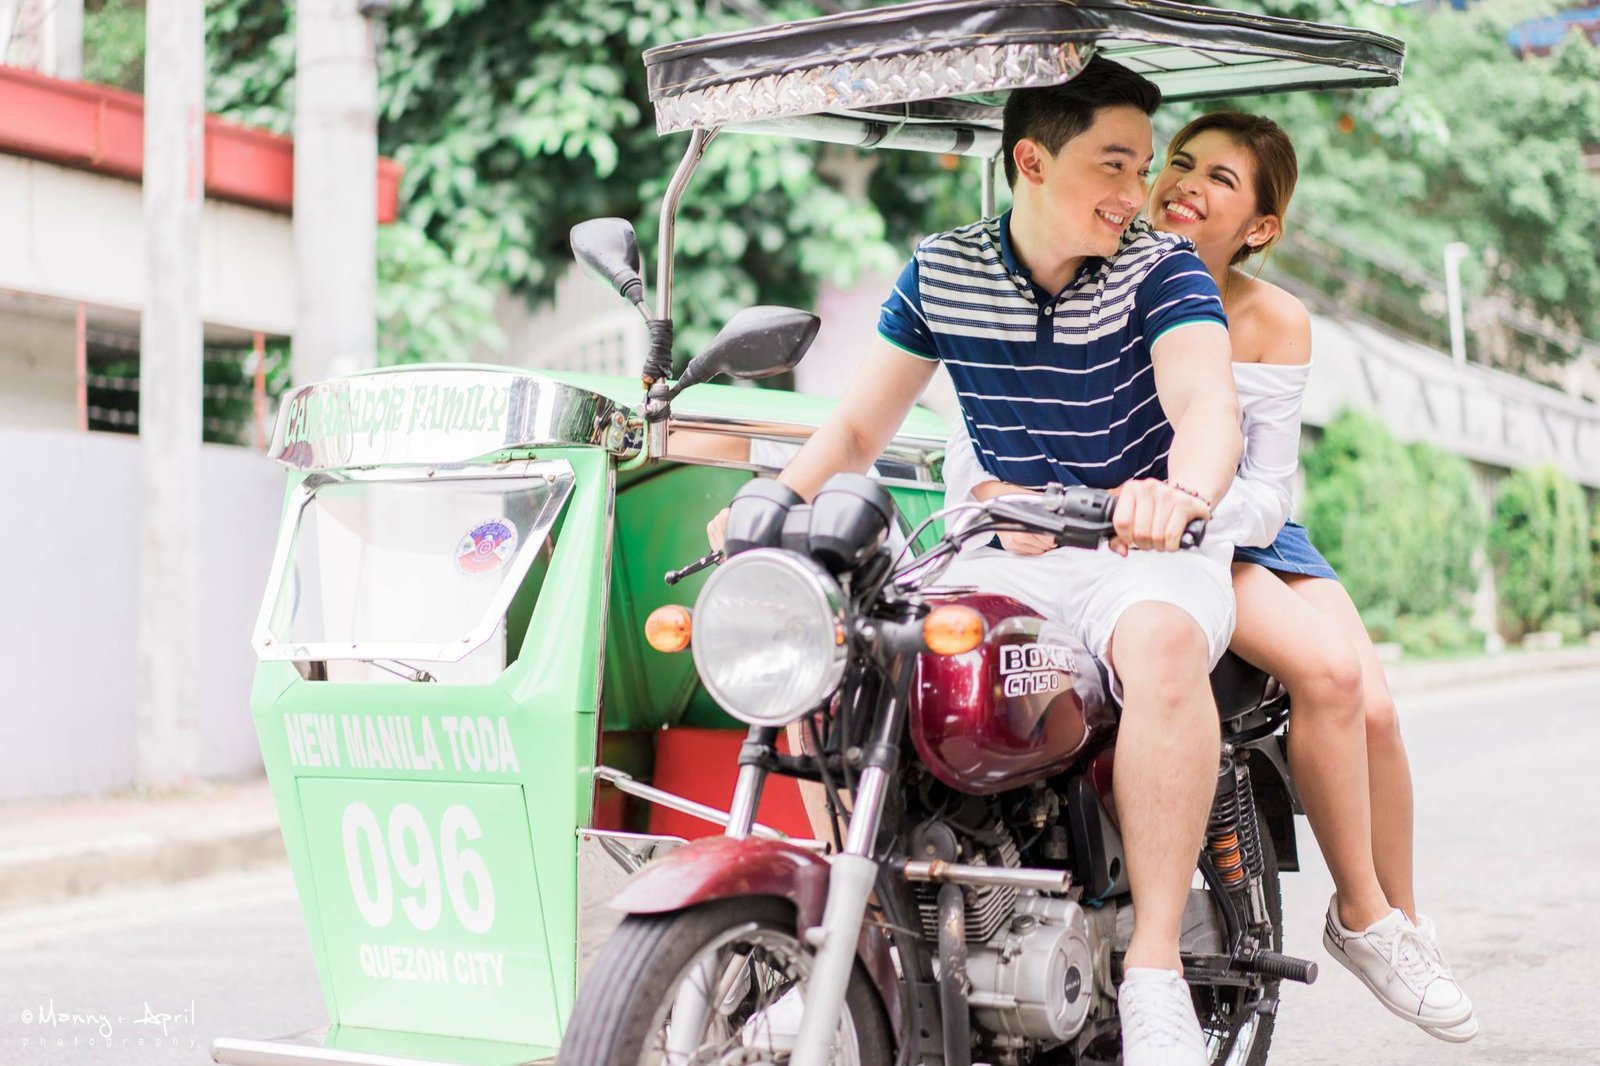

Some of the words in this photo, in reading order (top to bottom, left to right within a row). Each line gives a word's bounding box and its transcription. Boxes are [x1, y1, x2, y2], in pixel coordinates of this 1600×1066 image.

[406, 383, 509, 435] FAMILY
[999, 643, 1078, 675] BOXER
[1003, 670, 1061, 698] CT150
[285, 714, 340, 767] NEW
[341, 715, 444, 770] MANILA
[444, 716, 520, 773] TODA
[341, 802, 496, 934] 096
[360, 943, 447, 982] QUEZON
[453, 951, 504, 986] CITY
